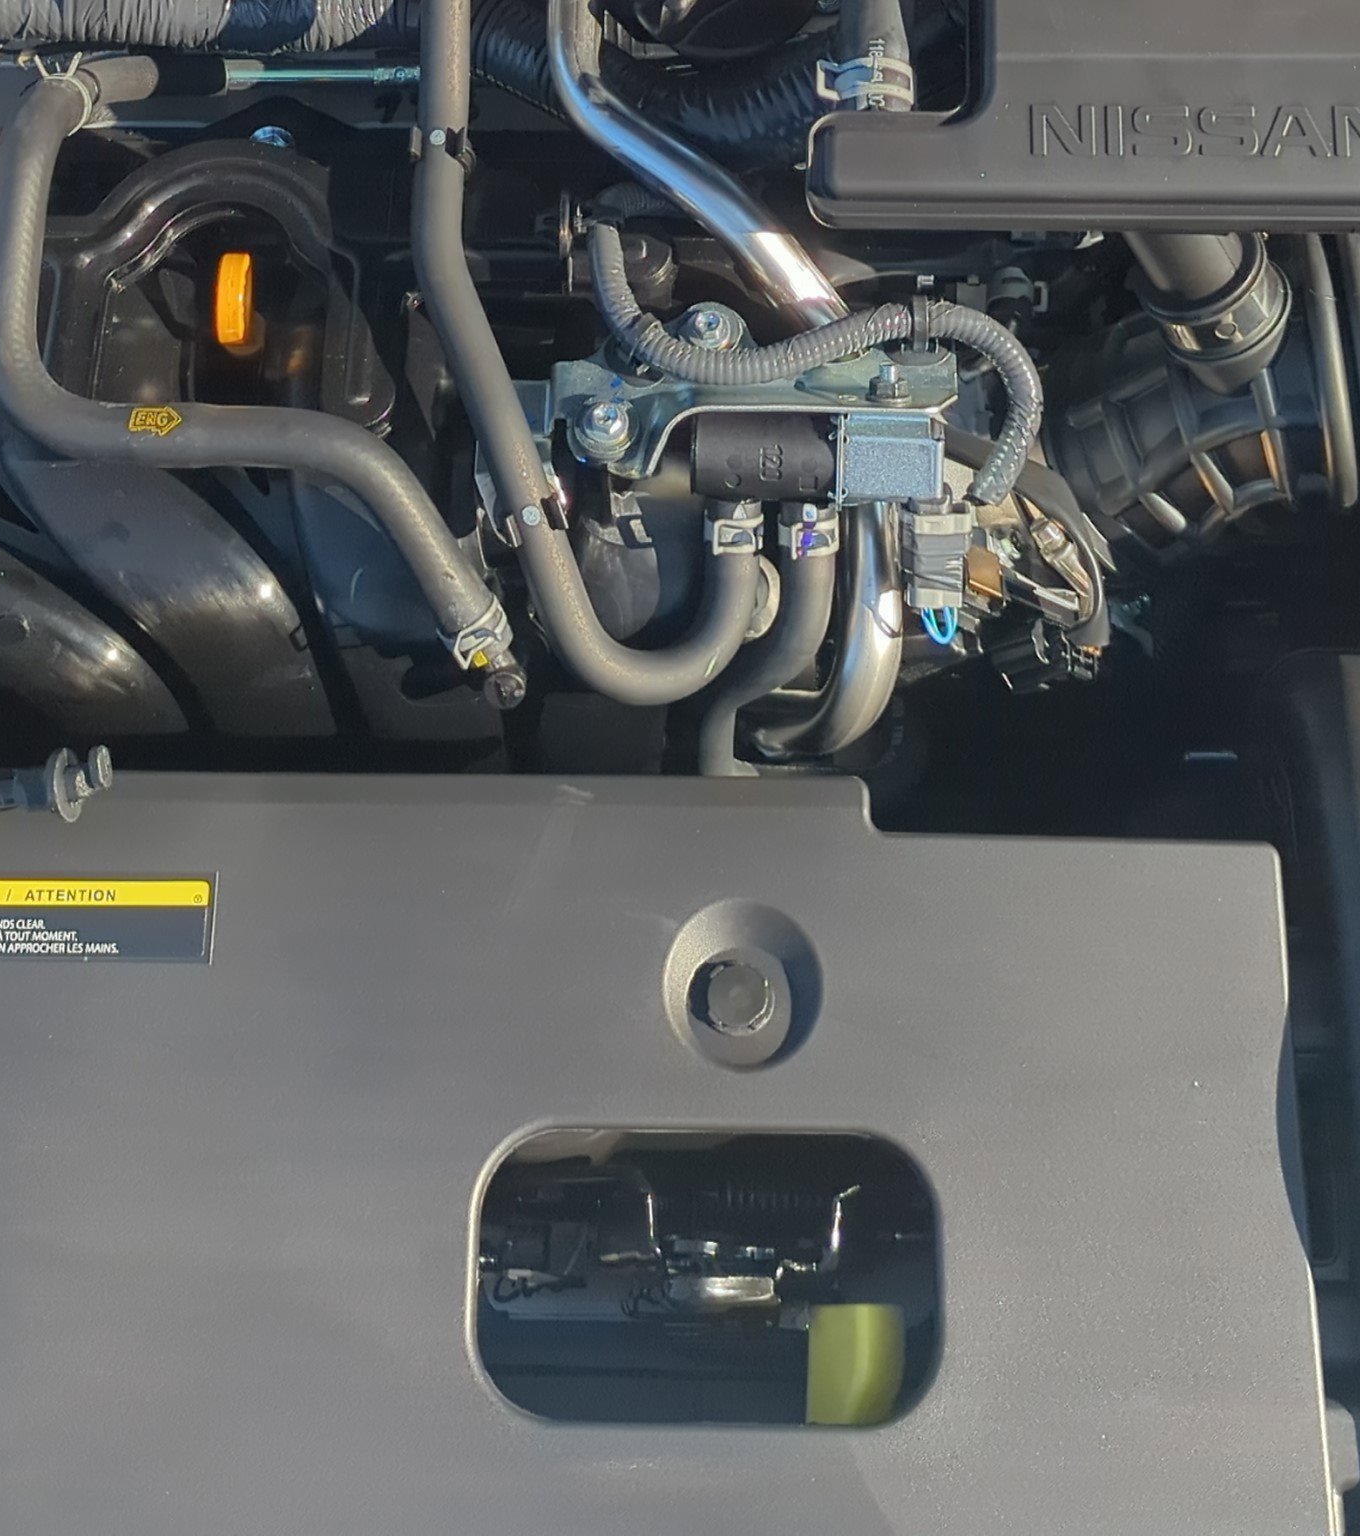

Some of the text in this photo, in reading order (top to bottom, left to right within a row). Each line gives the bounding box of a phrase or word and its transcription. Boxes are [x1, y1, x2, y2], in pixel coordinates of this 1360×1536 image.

[134, 412, 170, 427] ENG
[24, 888, 117, 902] ATTENTION
[5, 931, 31, 941] TOUT
[31, 931, 78, 941] MOMENT.
[8, 943, 65, 953] APPROCHER
[66, 943, 83, 953] LES
[84, 943, 119, 953] MAINS.
